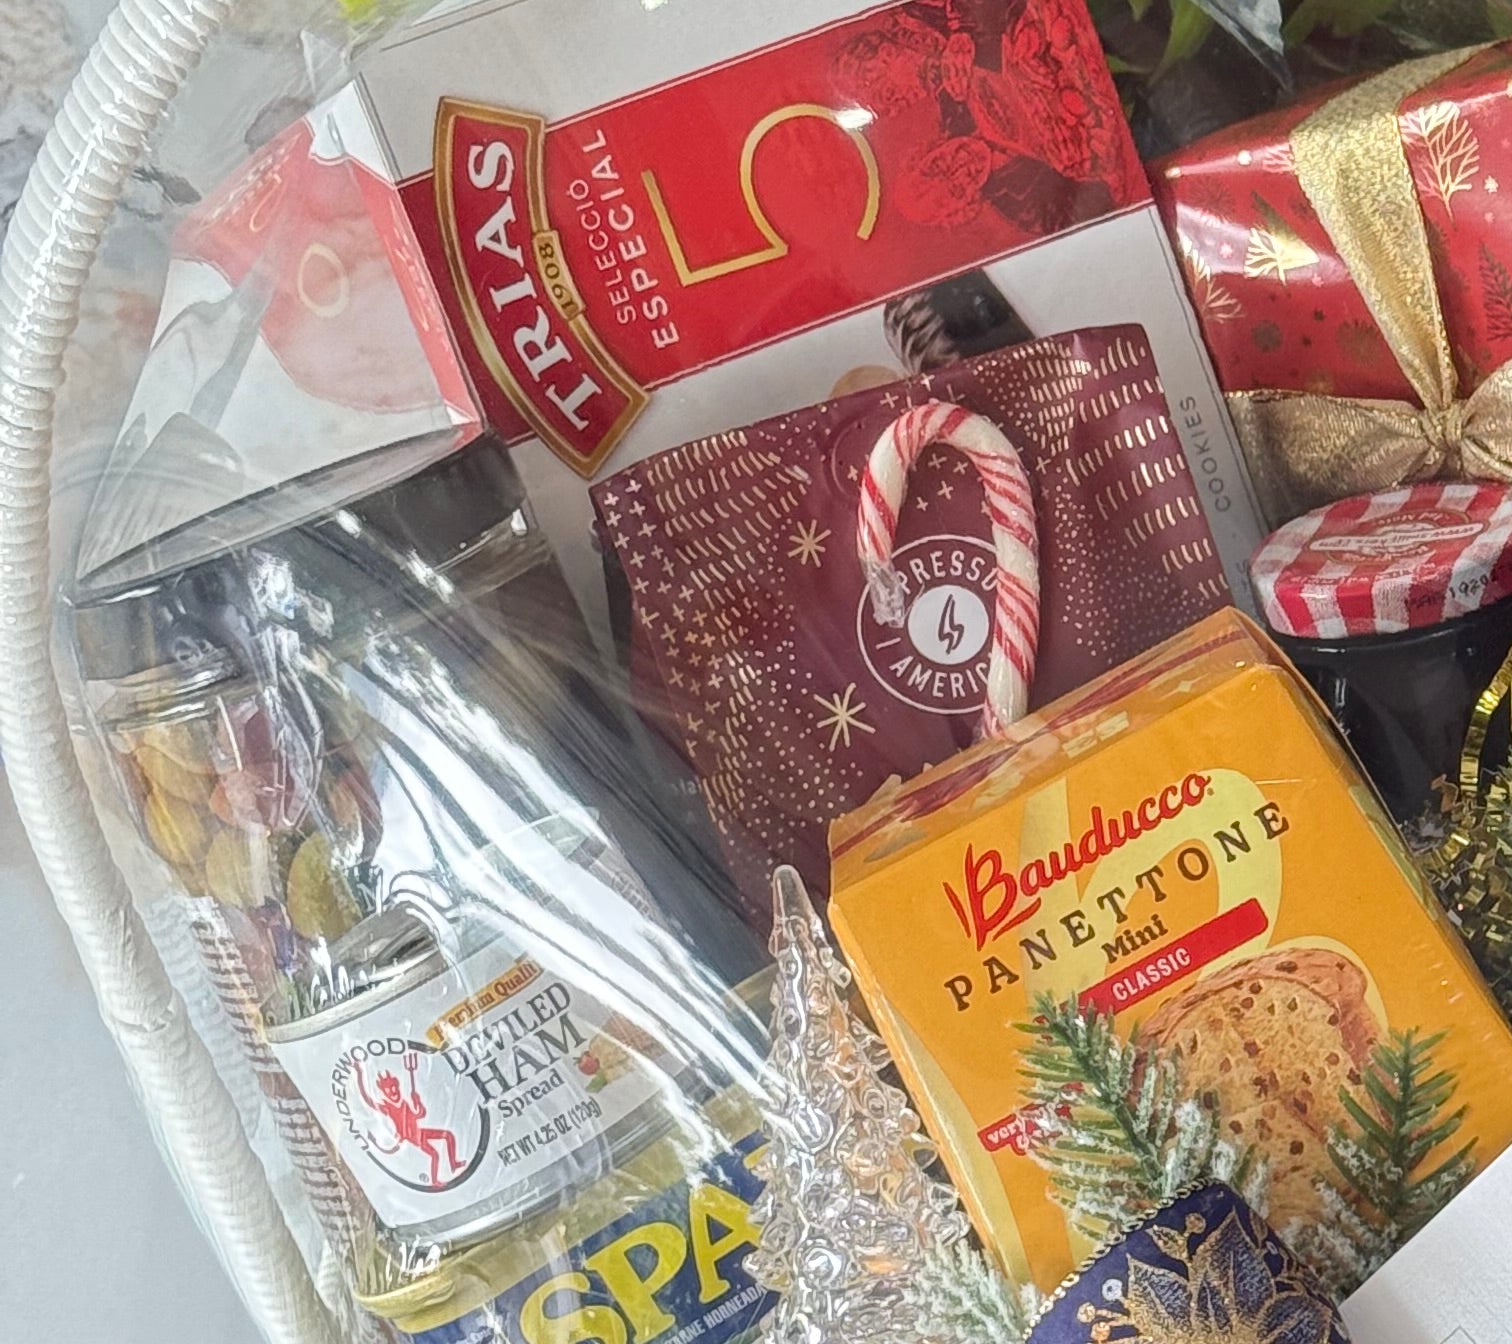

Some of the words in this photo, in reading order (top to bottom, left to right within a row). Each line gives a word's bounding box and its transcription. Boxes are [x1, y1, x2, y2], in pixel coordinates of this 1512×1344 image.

[566, 179, 638, 325] SELECCIÓ
[582, 129, 681, 349] ESPECIAL
[641, 103, 880, 287] 5
[467, 141, 602, 431] TRIAS
[538, 242, 575, 311] 1908
[1180, 395, 1231, 513] COOKIES
[888, 655, 990, 699] AMERIC
[942, 772, 1212, 952] Bauducco
[944, 802, 1290, 1012] PANETTONE
[1101, 913, 1169, 964] Mini
[1111, 946, 1192, 1002] CLASSIC
[441, 981, 571, 1075] DEVILED
[465, 1011, 588, 1105] HAM
[331, 1036, 406, 1151] UNDERWOOD
[498, 1067, 565, 1119] Spread
